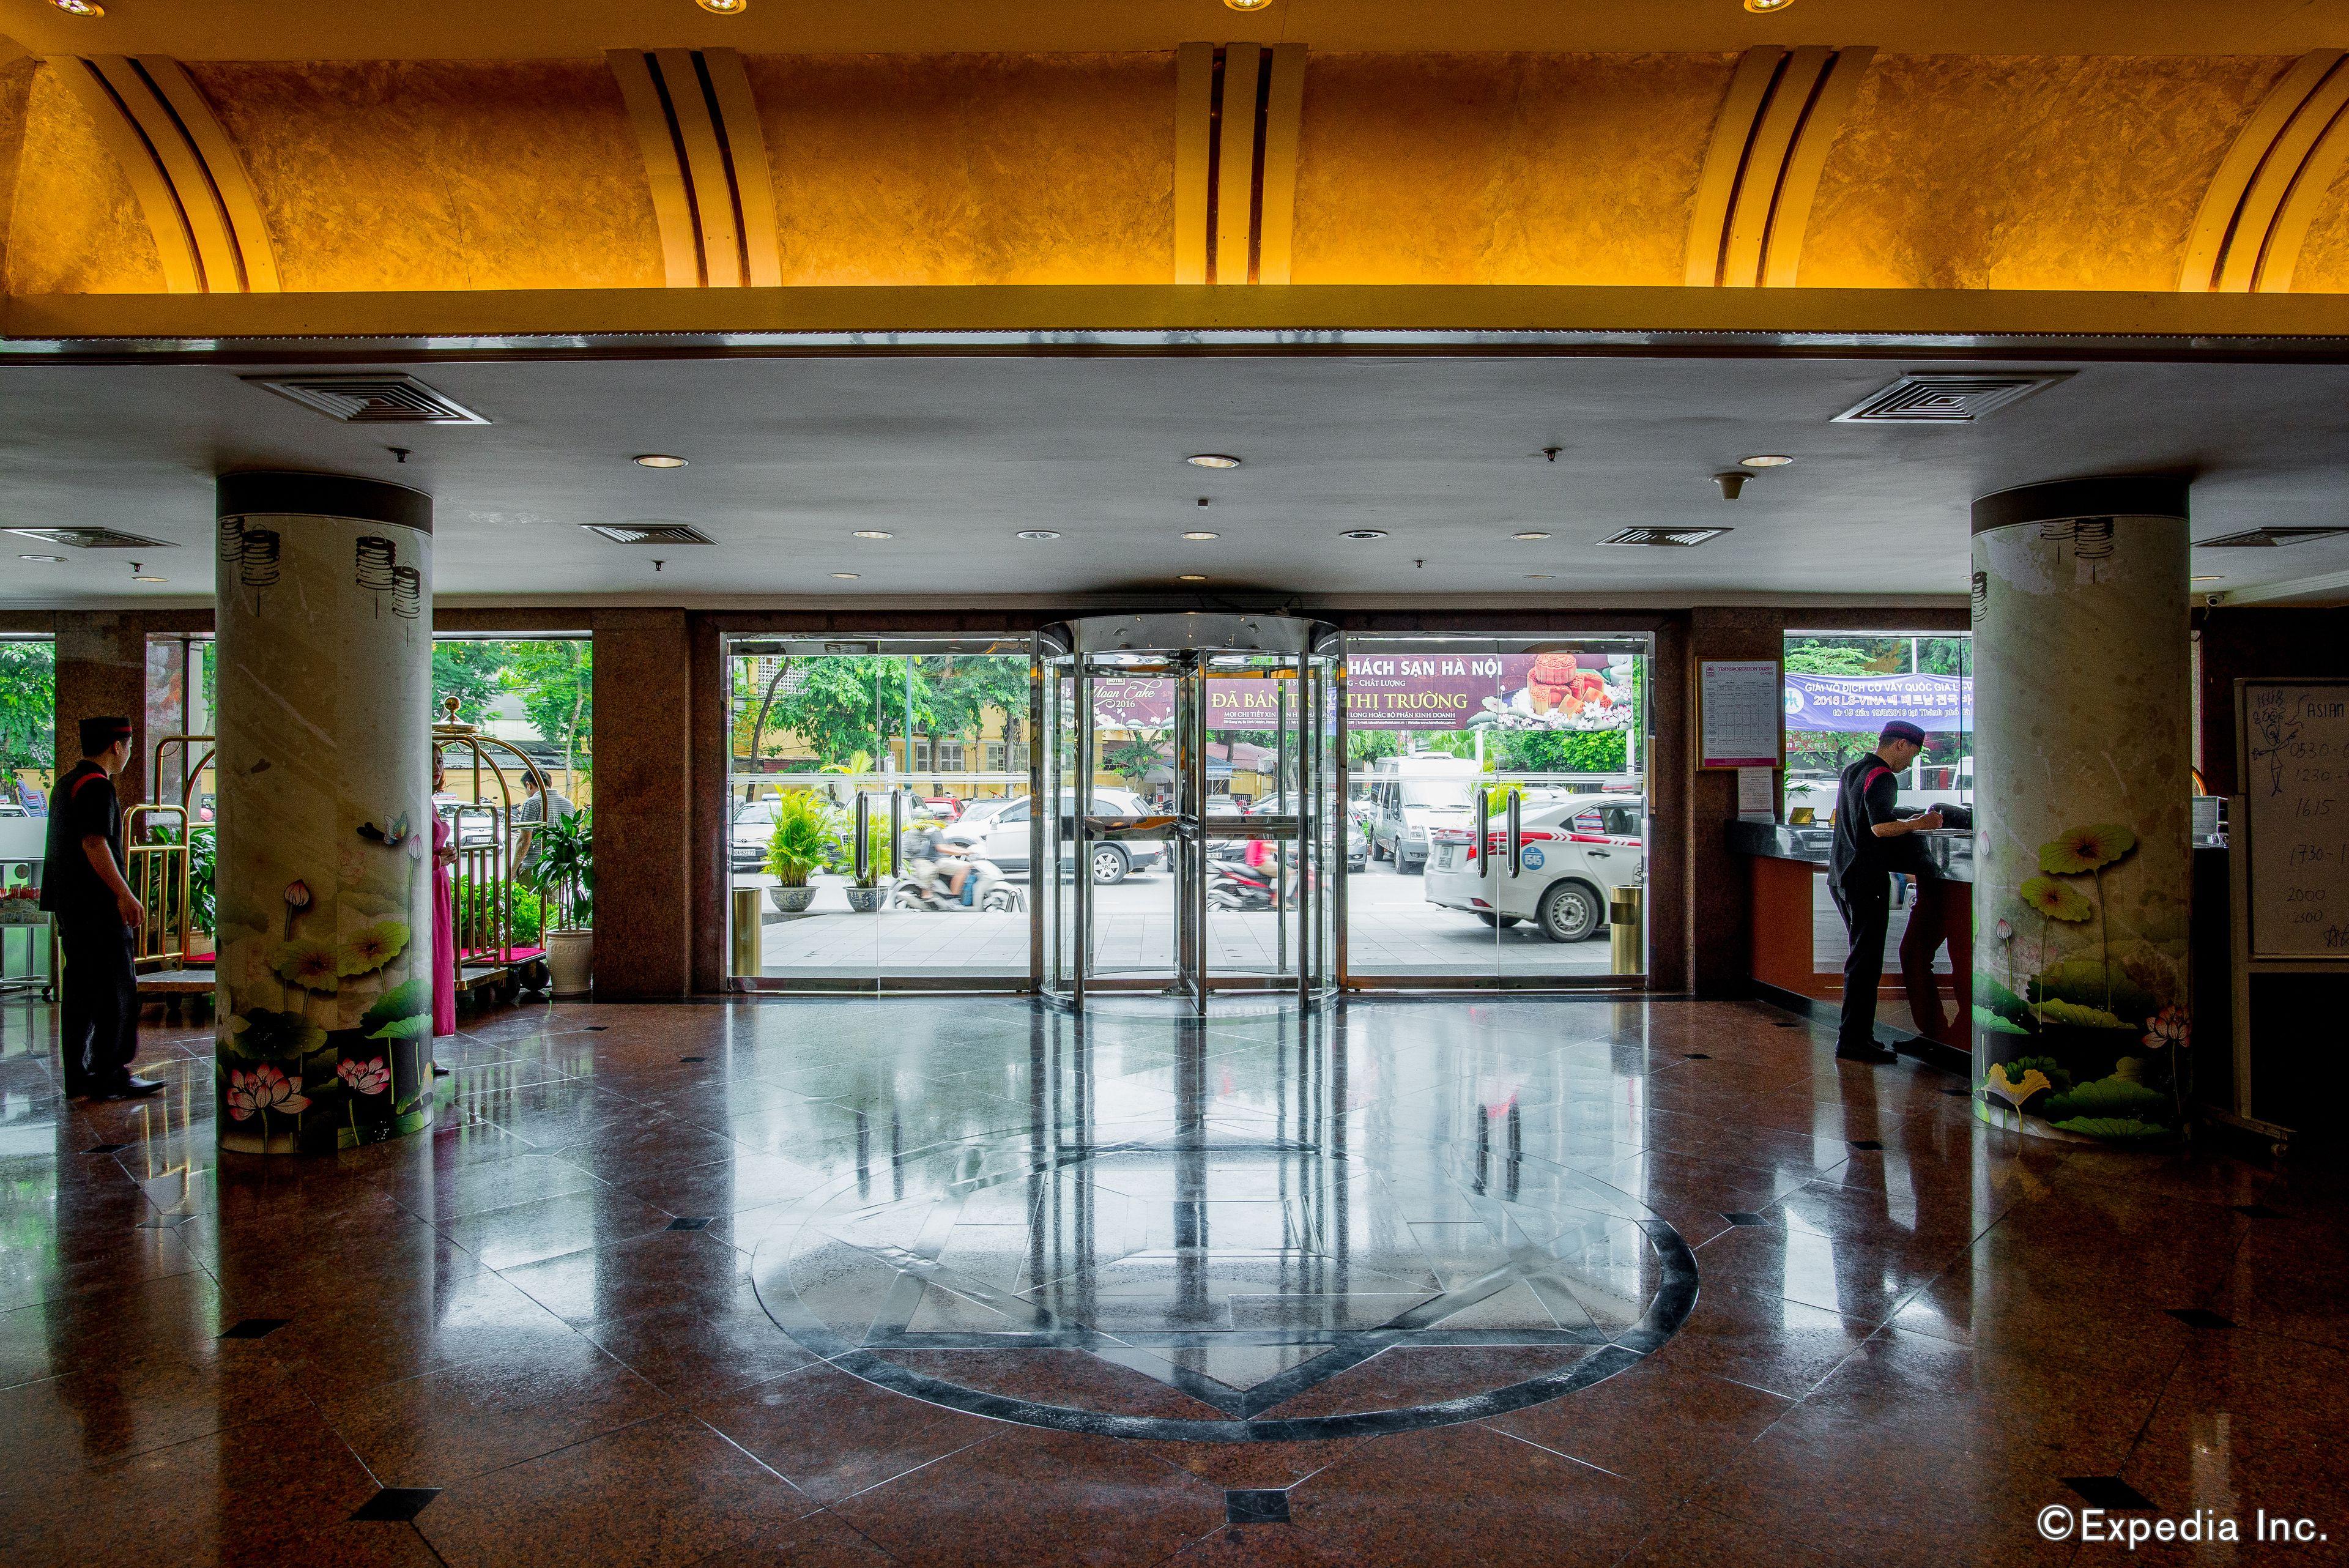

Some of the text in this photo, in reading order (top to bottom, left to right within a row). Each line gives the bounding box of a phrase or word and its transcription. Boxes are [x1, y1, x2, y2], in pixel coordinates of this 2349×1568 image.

[1348, 658, 1395, 675] HÁCH
[1401, 660, 1434, 677] SẠN
[1442, 658, 1466, 675] HÀ
[1472, 658, 1502, 678] NỘI
[1123, 679, 1162, 700] Cake
[1934, 683, 1951, 691] GIA
[1211, 690, 1240, 708] ĐÃ
[1244, 689, 1278, 708] BÁN
[1346, 693, 1379, 710] THỊ
[1384, 690, 1468, 708] TRƯỜNG
[1813, 695, 1840, 705] 2016
